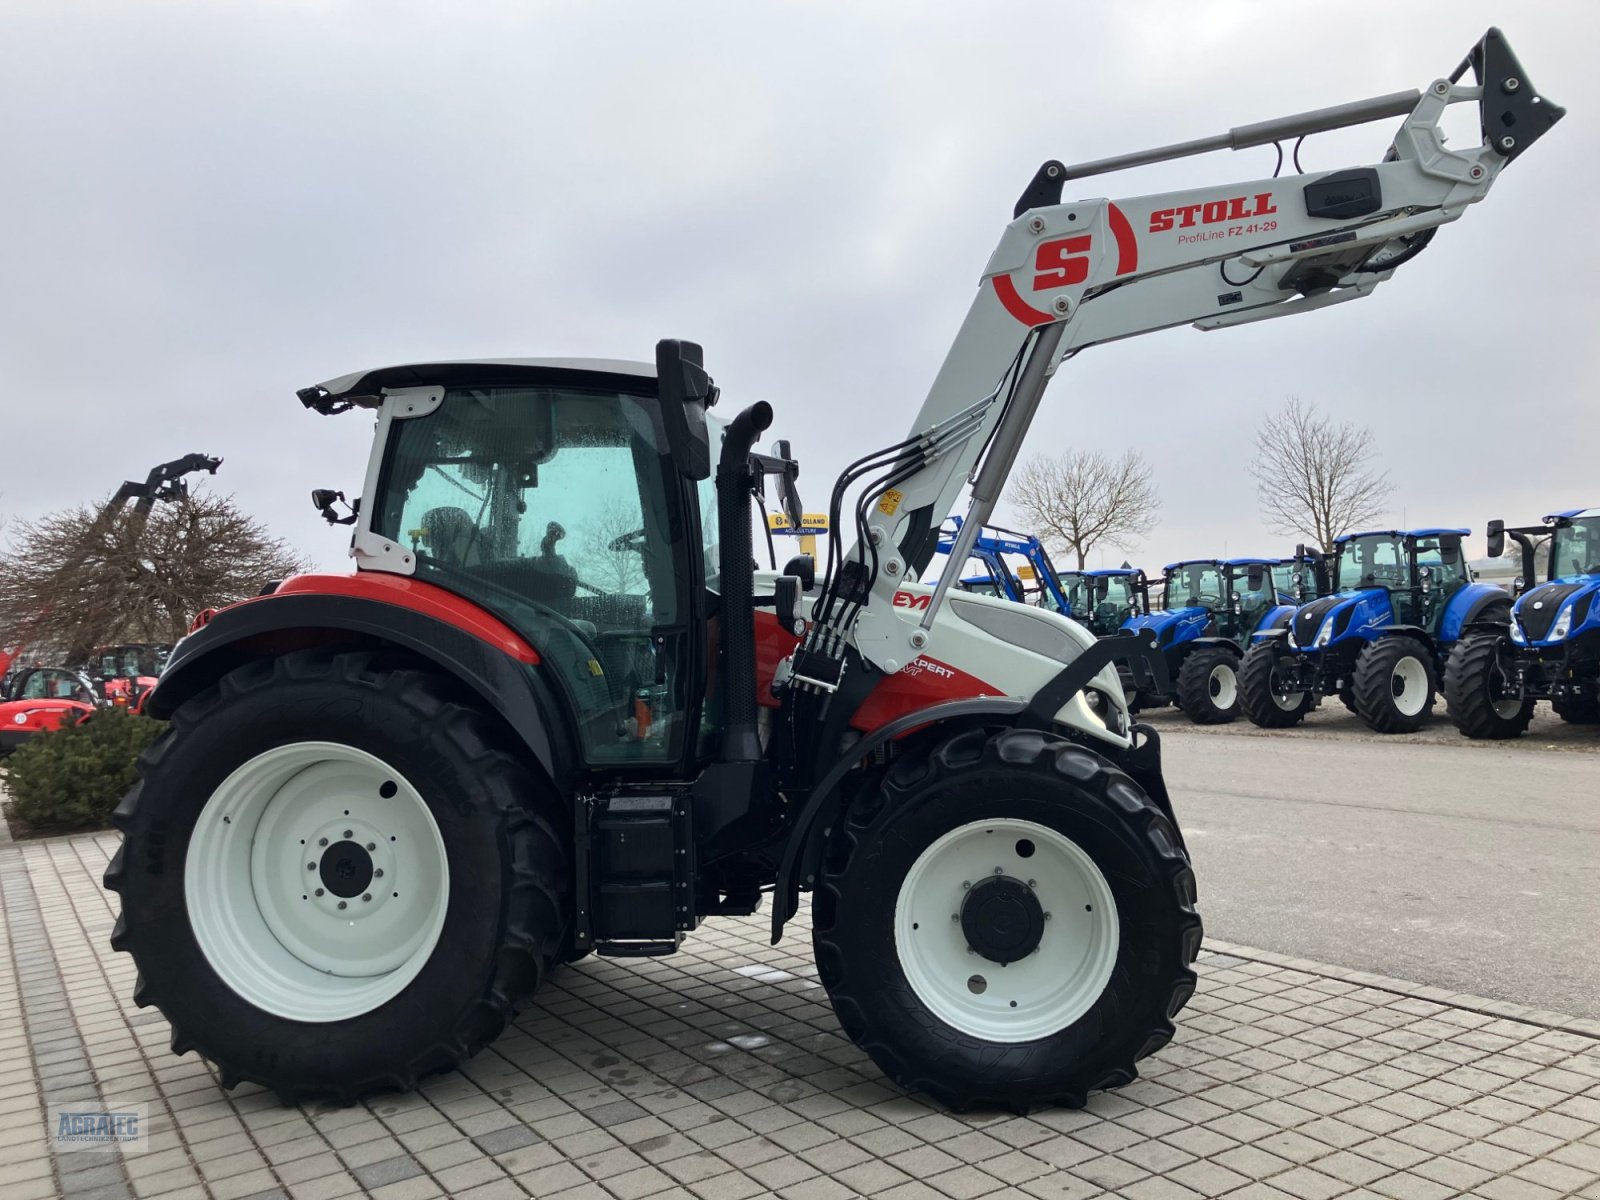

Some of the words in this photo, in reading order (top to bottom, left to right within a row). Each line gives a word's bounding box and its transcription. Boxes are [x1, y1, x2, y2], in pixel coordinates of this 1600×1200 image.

[1149, 192, 1278, 234] STOLL
[1178, 230, 1225, 245] ProfiLine
[1228, 226, 1243, 237] FZ
[1246, 221, 1277, 234] 41-29
[1032, 234, 1093, 291] S
[913, 658, 955, 678] XPERT
